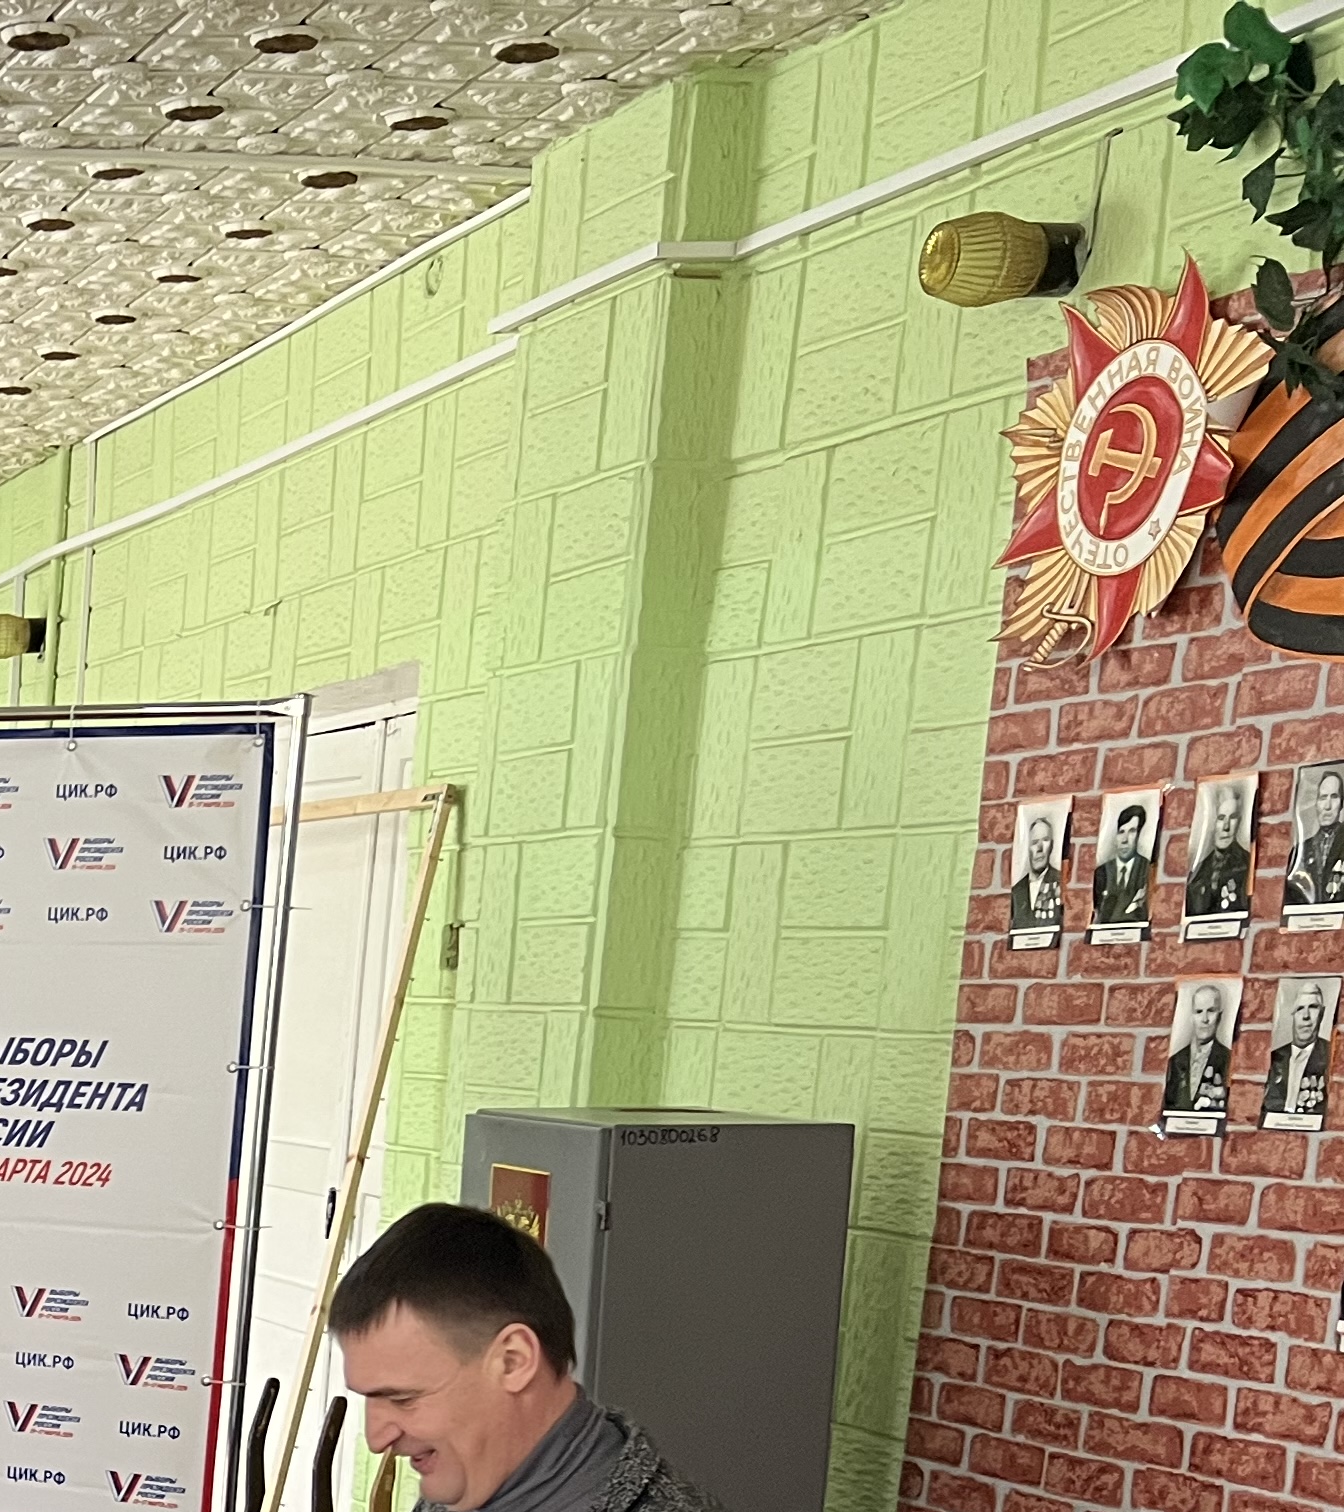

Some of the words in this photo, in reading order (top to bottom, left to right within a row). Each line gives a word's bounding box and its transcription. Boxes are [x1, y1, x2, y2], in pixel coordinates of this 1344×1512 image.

[1060, 345, 1161, 570] ОТЕЧЕСТВЕННАЯ
[56, 784, 117, 801] ЦИК.РФ
[164, 846, 227, 863] ЦИК.РФ
[48, 907, 108, 924] ЦИК.РФ
[52, 1160, 113, 1188] 2024
[128, 1303, 189, 1321] ЦИК.РФ
[16, 1352, 74, 1369] ЦИК.РФ
[120, 1421, 180, 1439] ЦИК.РФ
[7, 1466, 65, 1485] ЦИК.РФ
